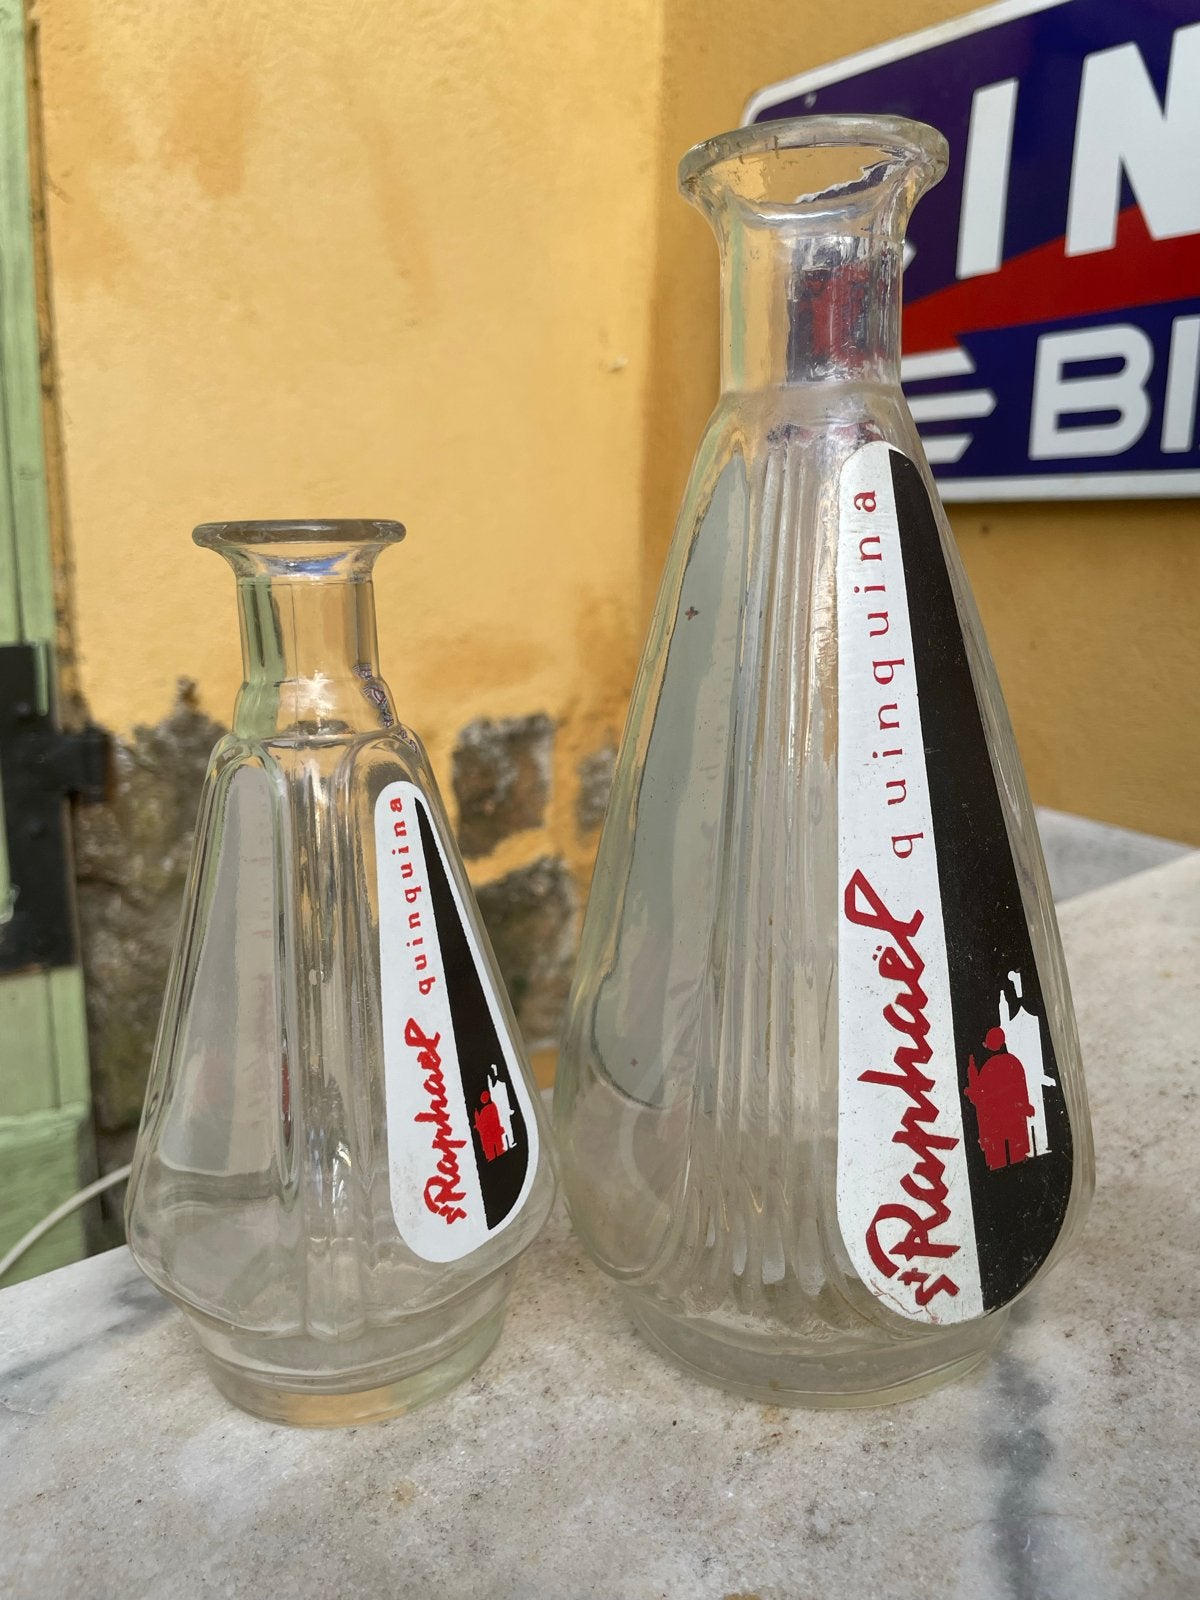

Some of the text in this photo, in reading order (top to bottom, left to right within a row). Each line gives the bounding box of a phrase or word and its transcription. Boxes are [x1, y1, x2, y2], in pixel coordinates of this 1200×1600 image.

[903, 20, 1200, 282] IN
[1028, 313, 1200, 462] BI
[853, 490, 924, 859] quinquina
[390, 797, 436, 996] quinquina
[844, 869, 961, 1279] Raphaël
